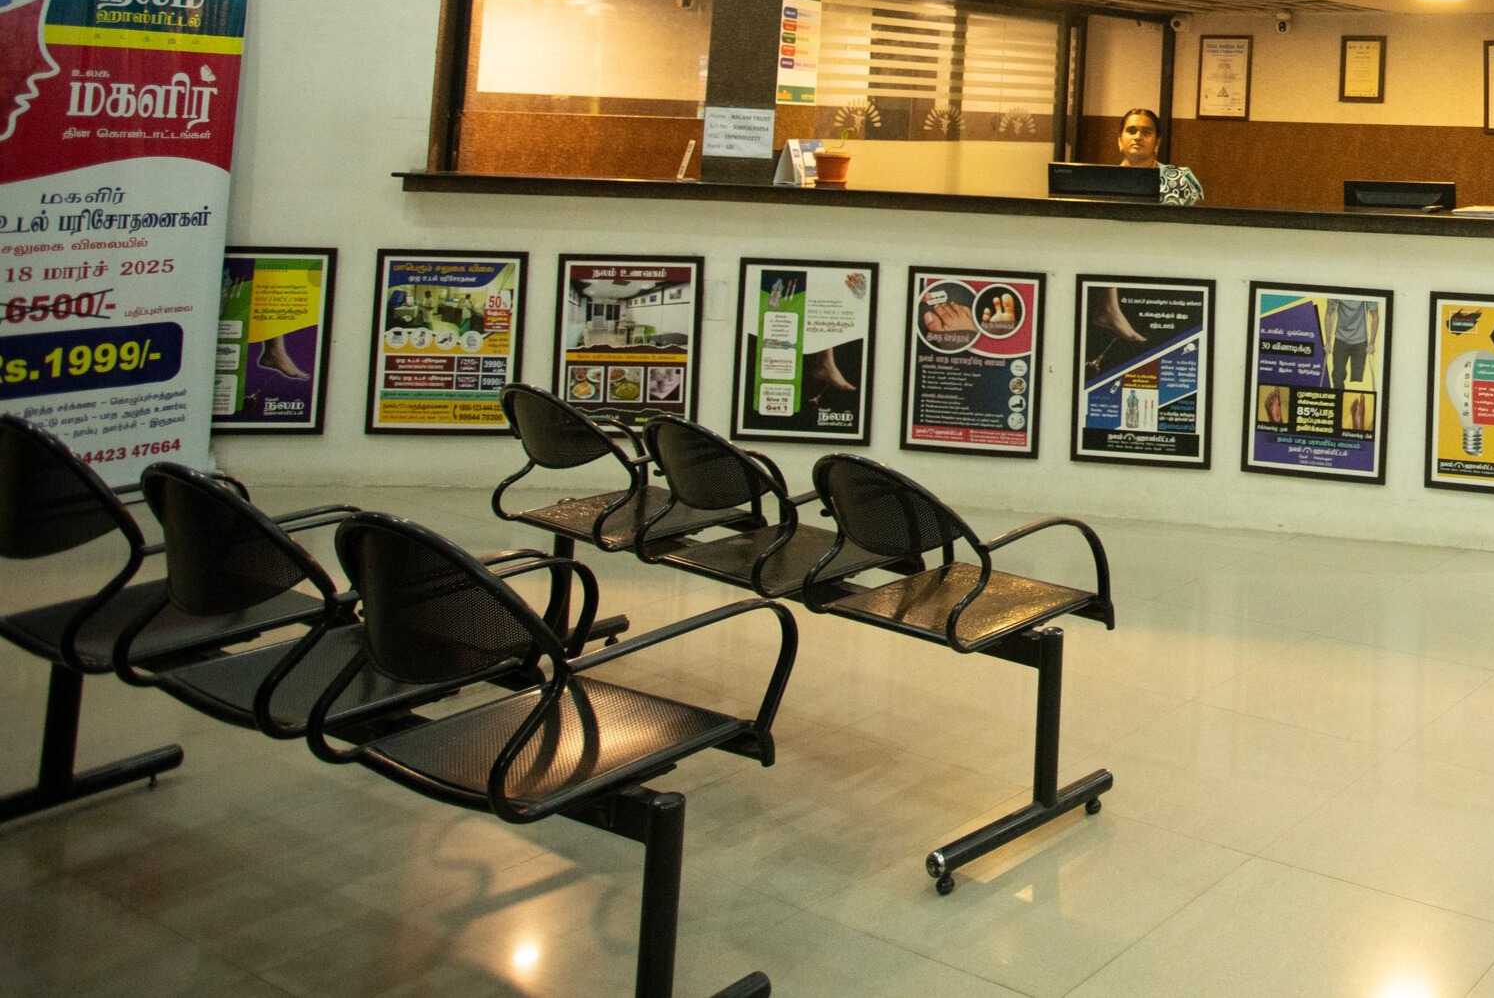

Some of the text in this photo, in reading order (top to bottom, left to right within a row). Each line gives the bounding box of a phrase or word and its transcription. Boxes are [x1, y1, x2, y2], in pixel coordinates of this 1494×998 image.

[66, 72, 218, 130] மகளிர்
[40, 187, 126, 206] மகளிர்
[6, 266, 32, 282] 18
[120, 259, 175, 276] 2025
[1261, 342, 1270, 350] 30
[0, 339, 160, 383] s.1999/-
[132, 438, 181, 457] 47664
